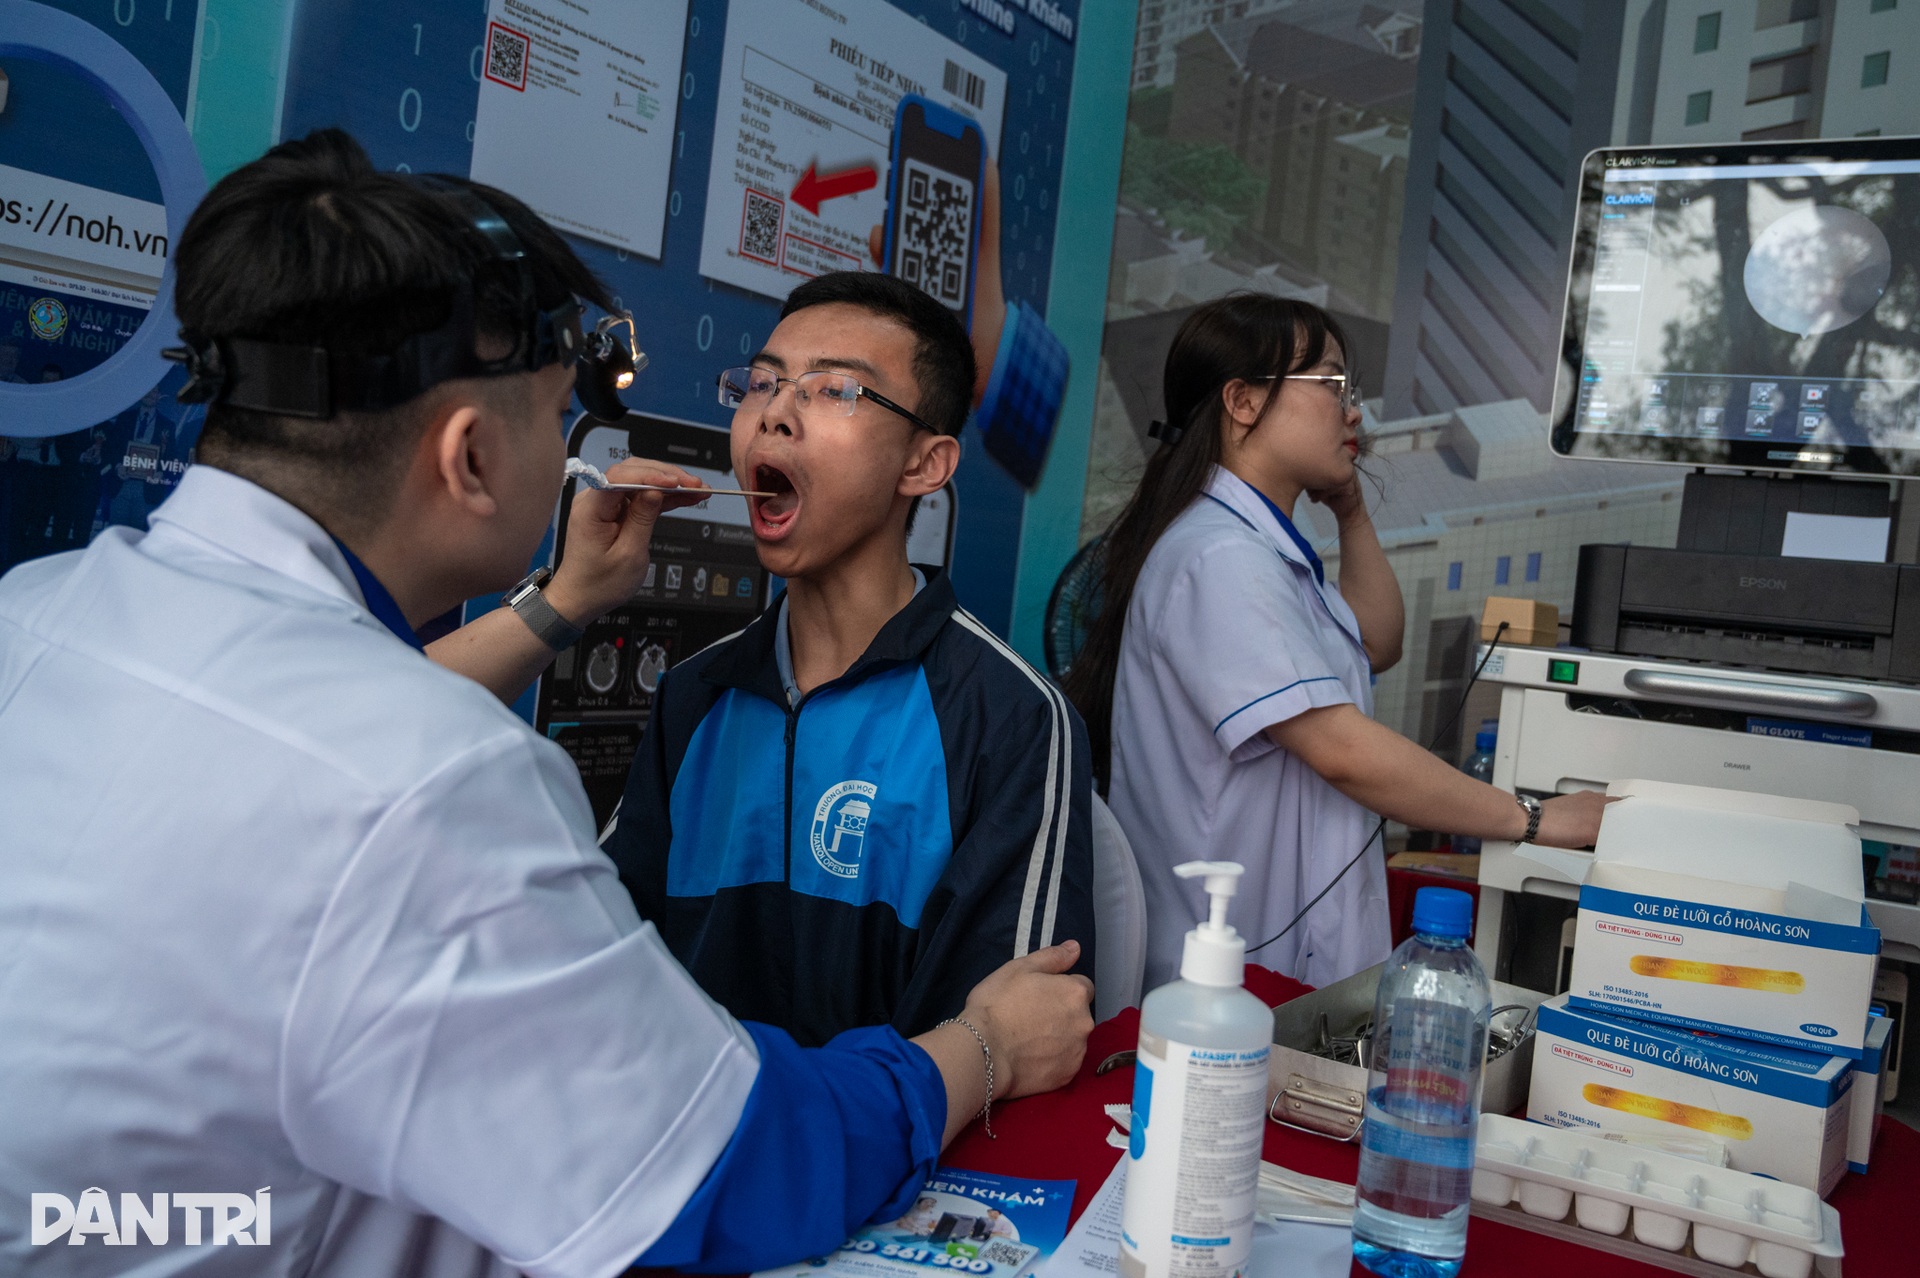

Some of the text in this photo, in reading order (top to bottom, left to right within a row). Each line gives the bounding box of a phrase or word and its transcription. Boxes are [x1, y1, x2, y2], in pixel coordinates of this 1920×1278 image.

[829, 36, 868, 70] PHIẾU
[868, 58, 894, 83] TIẾP
[123, 453, 157, 471] BỆNH
[1739, 576, 1787, 591] EPSON
[1751, 725, 1805, 739] HM GLOVE
[1723, 761, 1751, 771] DRAWER
[856, 784, 874, 795] HỌC
[813, 832, 825, 860] HANOI
[822, 858, 845, 875] OPEN
[1633, 901, 1811, 940] QUE ĐÈ LƯỠI GỖ HOÀNG SƠN
[1621, 926, 1641, 936] TRÙNG
[1645, 930, 1663, 940] DÙNG
[1588, 990, 1602, 999] SLH:
[1603, 984, 1614, 992] ISO
[1634, 991, 1649, 999] 2016
[1625, 1008, 1650, 1018] MEDICAL
[1651, 1013, 1684, 1025] EQUIPMENT
[1685, 1018, 1737, 1035] MANUFACTURING
[1737, 1028, 1751, 1037] AND
[1808, 1042, 1833, 1052] LIMITED
[1805, 1025, 1832, 1036] 100 QUE
[1190, 1049, 1238, 1062] ALFASEPT
[1587, 1028, 1759, 1085] QUE ĐÈ LƯỠI GỖ HOÀNG SƠN
[1543, 1114, 1556, 1124] SLH:
[1557, 1110, 1568, 1119] ISO
[1587, 1119, 1601, 1128] 2016
[971, 1186, 1045, 1206] KHÁM
[881, 1243, 929, 1262] 561
[931, 1253, 989, 1273] 500
